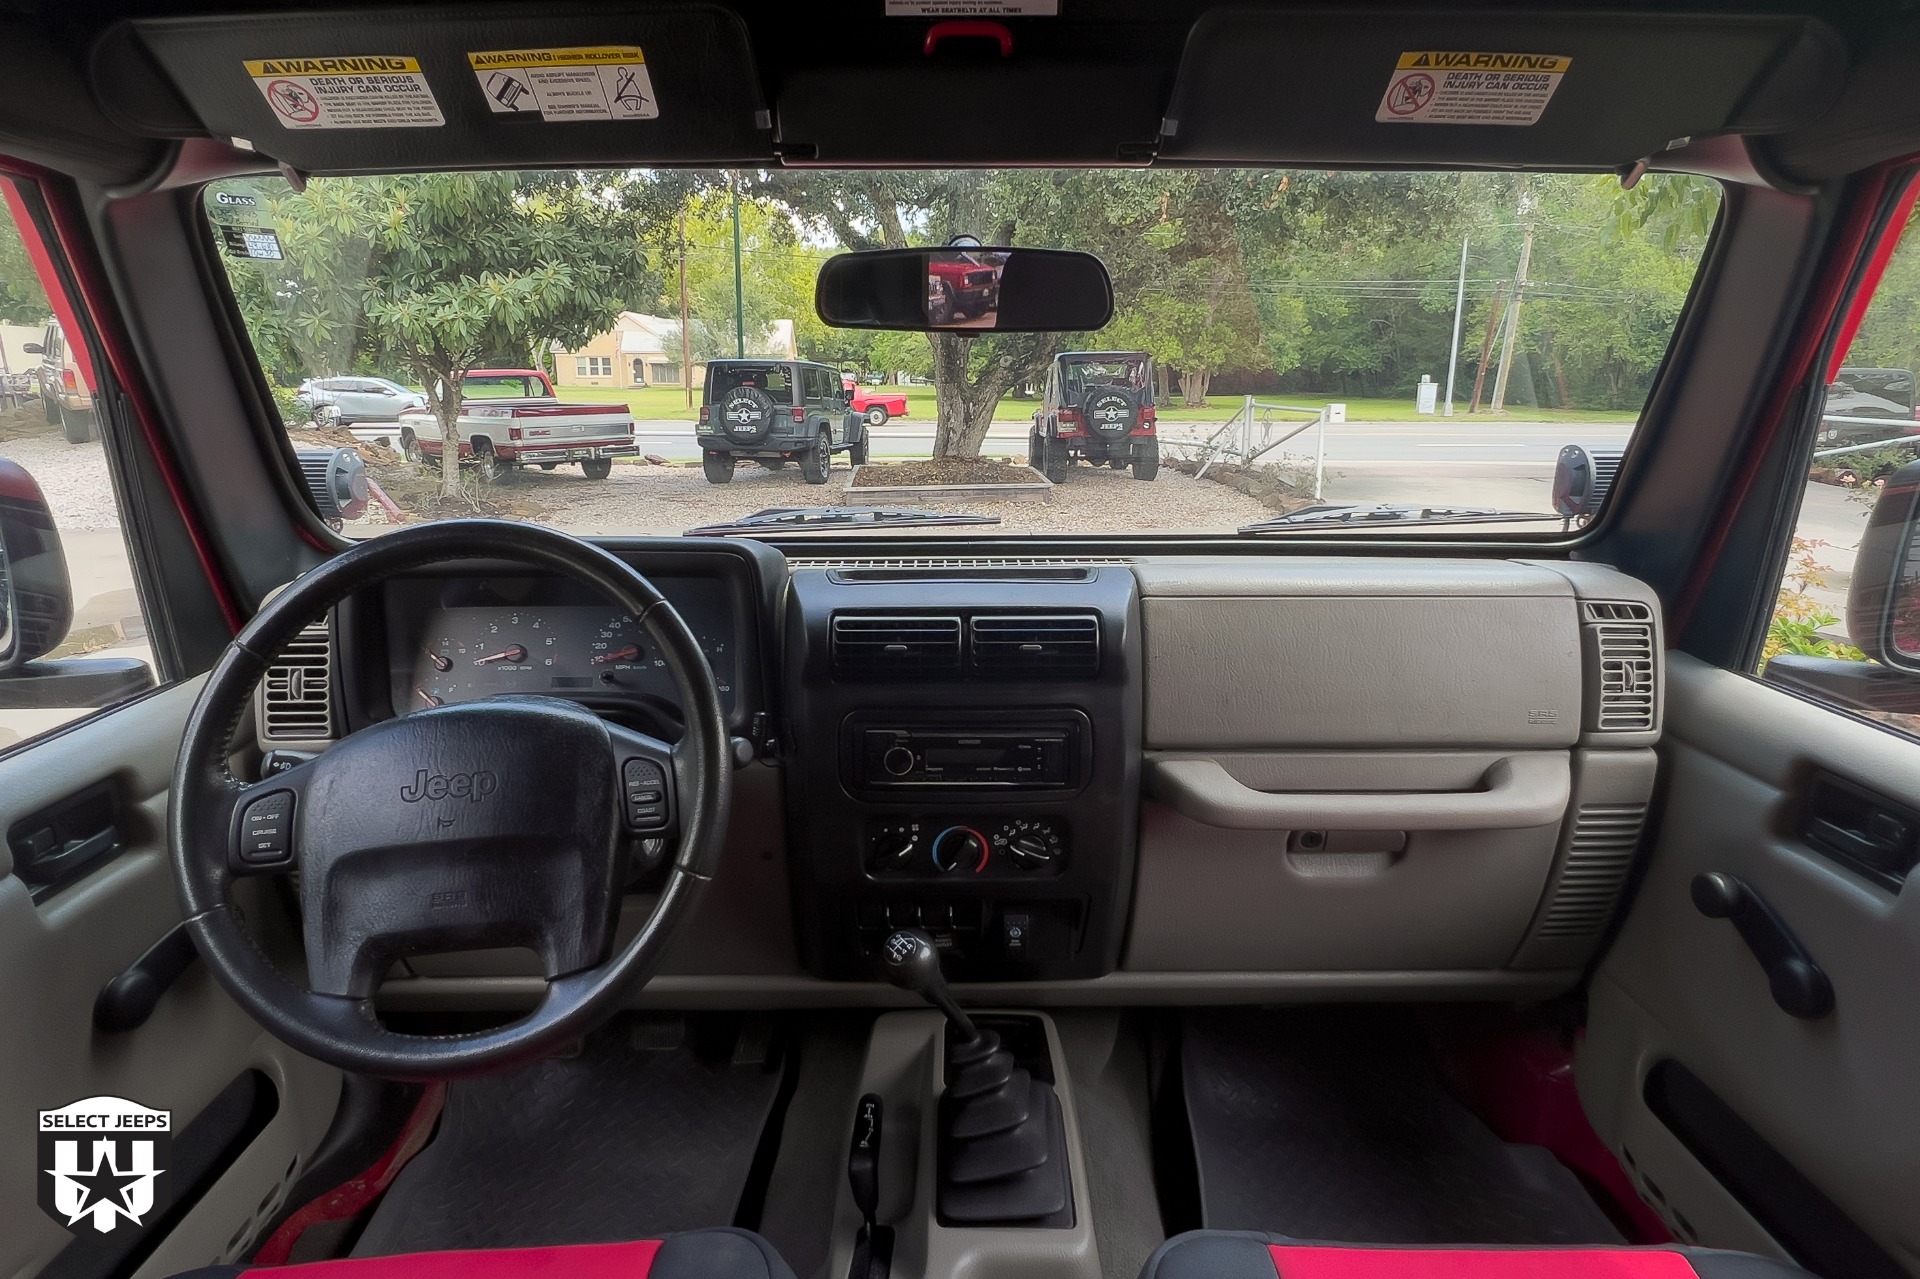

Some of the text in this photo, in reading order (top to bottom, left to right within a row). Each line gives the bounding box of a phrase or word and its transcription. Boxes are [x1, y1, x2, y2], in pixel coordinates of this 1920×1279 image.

[276, 57, 407, 74] WARNING
[1433, 54, 1560, 69] WARNING
[309, 75, 415, 86] DEATH OR SERIOUS
[1447, 72, 1551, 83] DEATH OR SERIOUS
[313, 83, 422, 94] INJURY CAN OCCUR
[1442, 81, 1550, 91] INJURY CAN OCCUR
[729, 397, 759, 409] SELECT
[1096, 396, 1127, 408] SELECT
[733, 425, 757, 433] JEEPS
[1100, 422, 1124, 431] JEEPS
[490, 625, 498, 633] 2
[608, 621, 621, 629] 40
[545, 637, 553, 645] 5
[594, 642, 608, 650] 20
[544, 658, 552, 666] 6
[400, 768, 498, 804] Jeep
[637, 806, 656, 814] COAST
